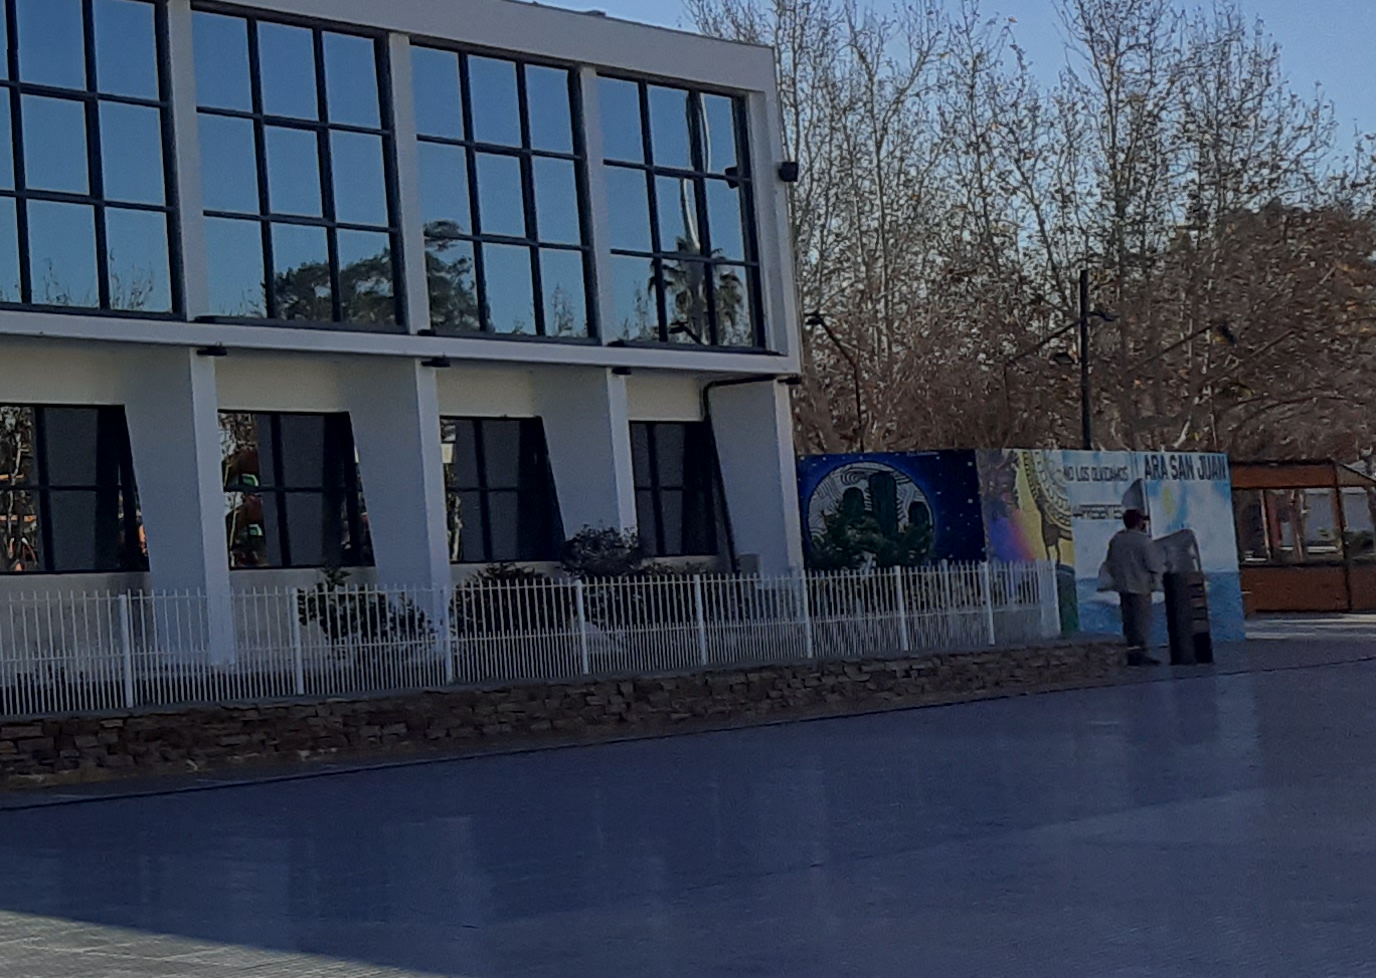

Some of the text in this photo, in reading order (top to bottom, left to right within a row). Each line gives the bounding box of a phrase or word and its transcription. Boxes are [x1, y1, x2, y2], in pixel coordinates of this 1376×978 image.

[1143, 455, 1227, 481] ARA SAN JUAN
